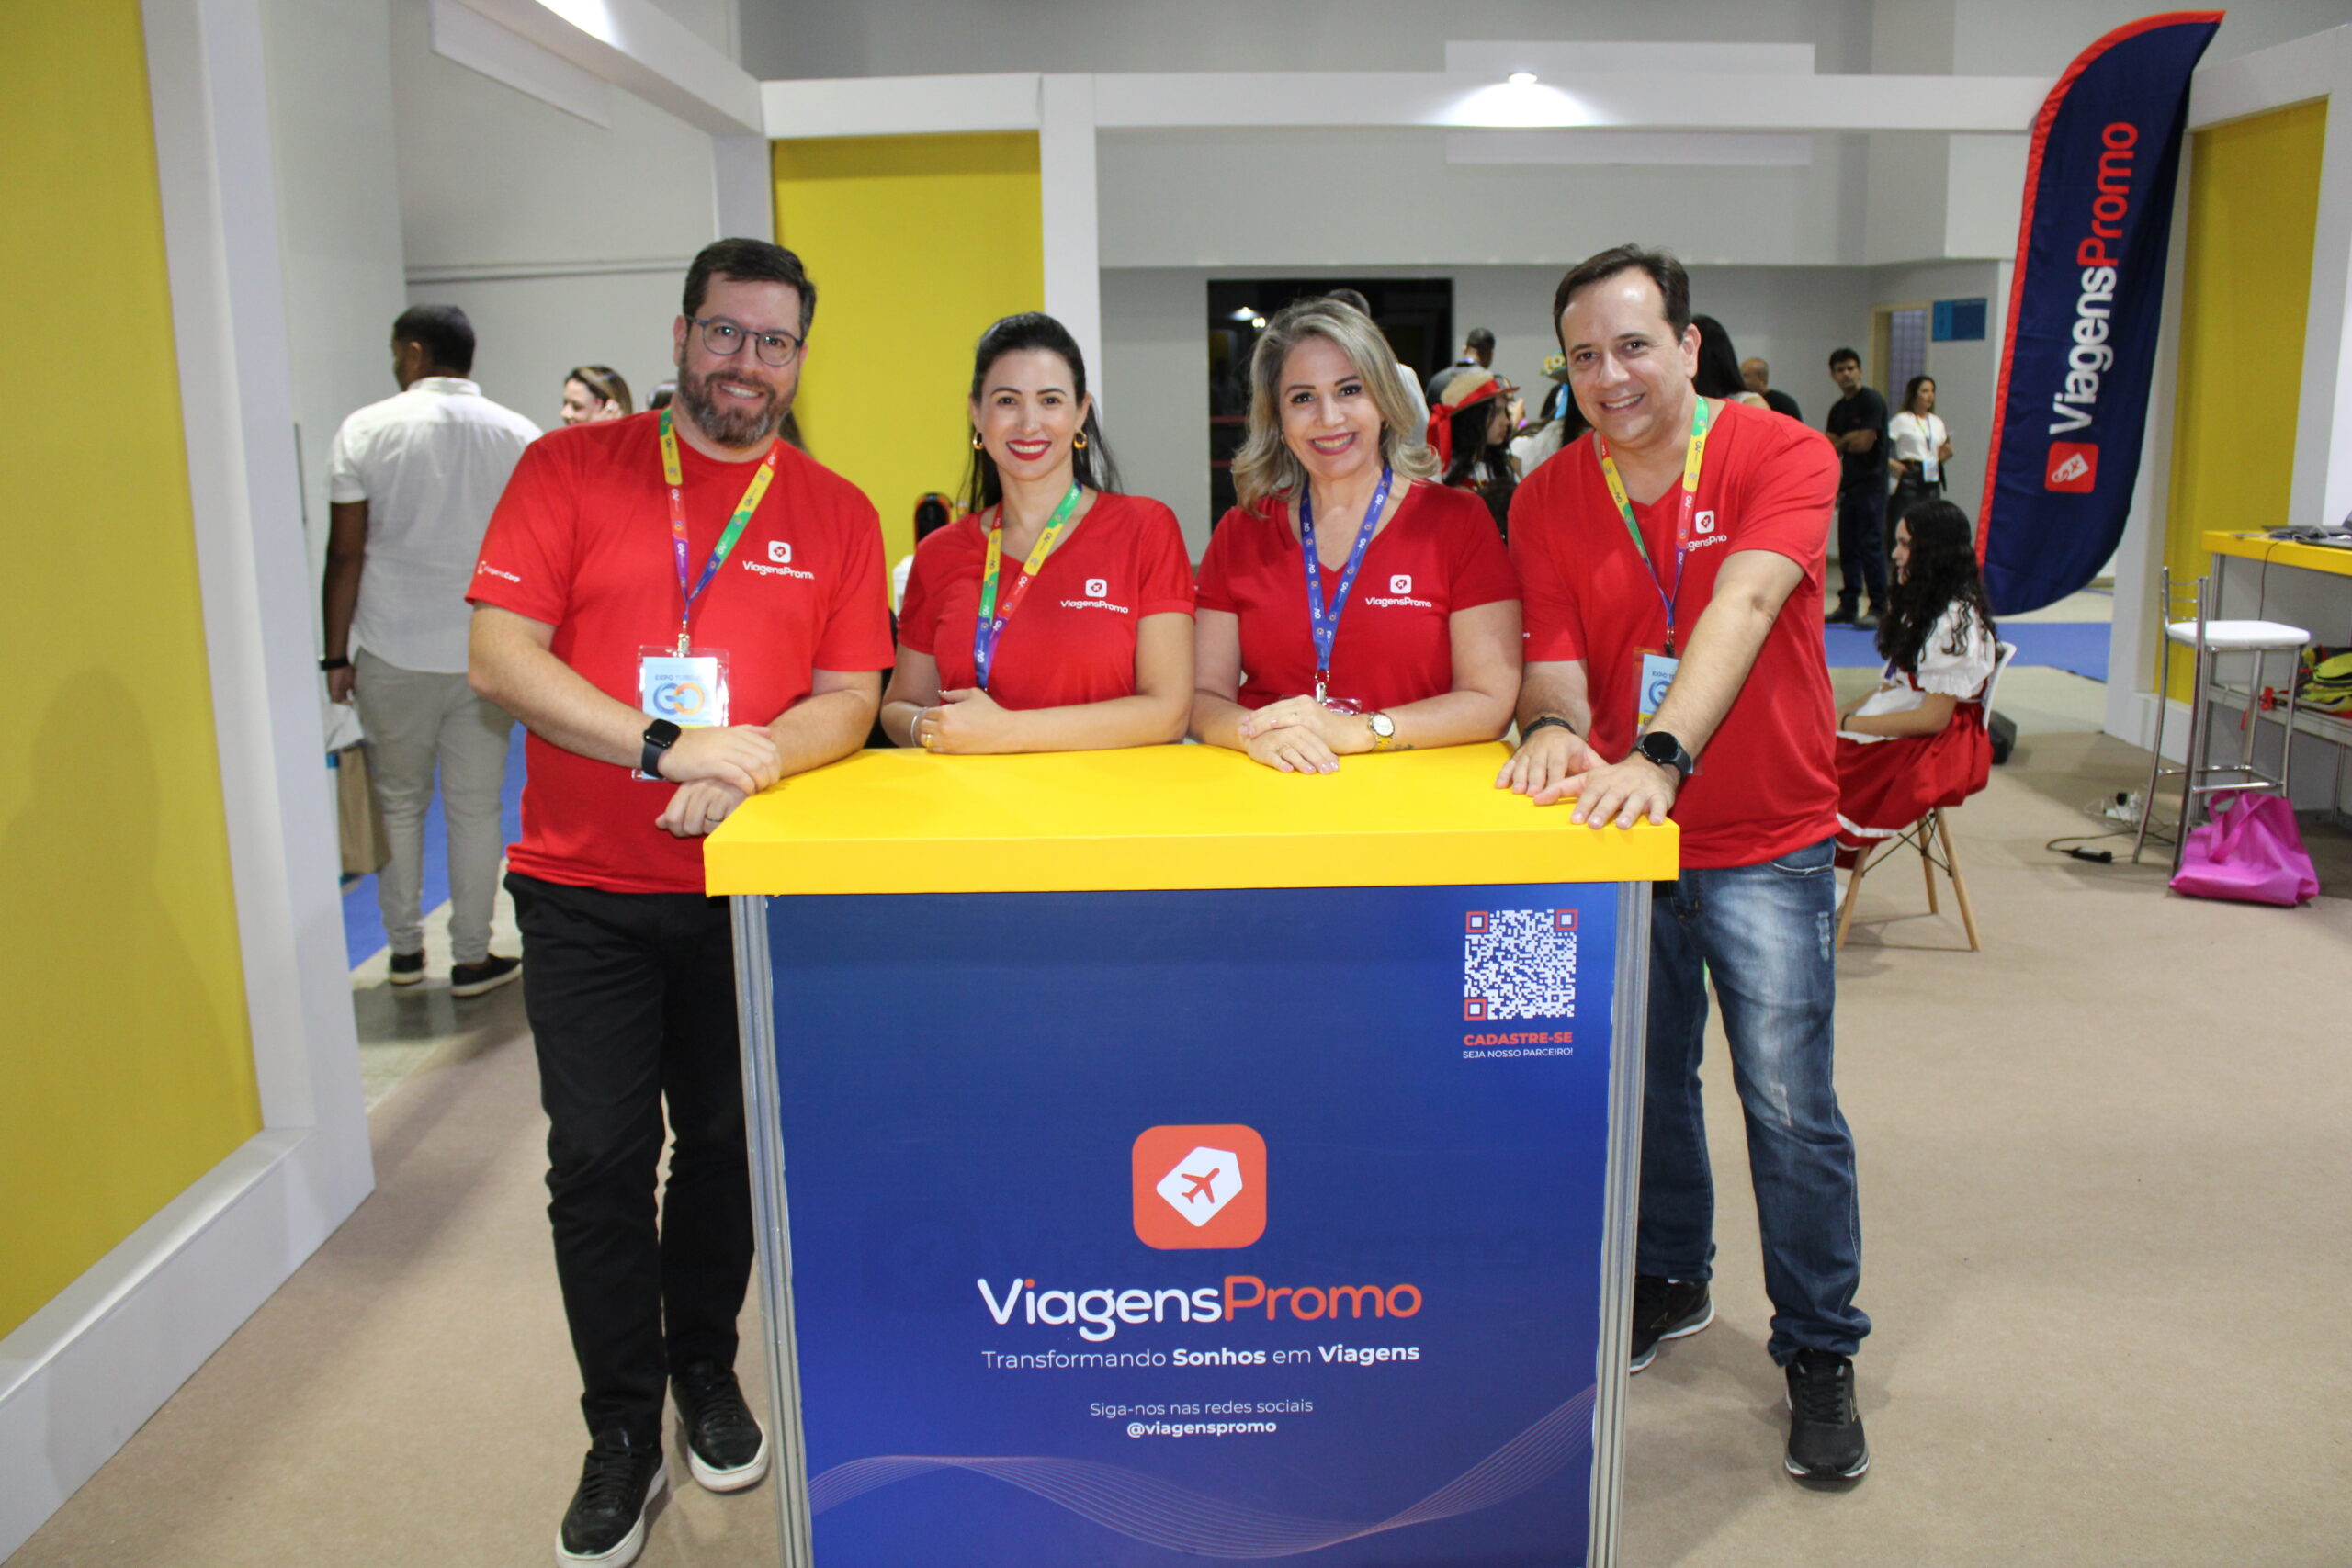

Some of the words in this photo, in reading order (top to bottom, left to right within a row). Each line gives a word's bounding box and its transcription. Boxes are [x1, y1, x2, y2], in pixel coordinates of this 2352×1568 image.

[2048, 122, 2139, 436] ViagensPromo
[1060, 600, 1129, 614] ViagensPromo
[1365, 597, 1432, 607] ViagensPromo
[1463, 1032, 1573, 1045] CADASTRE-SE
[1463, 1050, 1486, 1059] SEJA
[1487, 1049, 1521, 1058] NOSSO
[1522, 1047, 1574, 1056] PARCEIRO!
[977, 1275, 1423, 1342] ViagensPromo
[981, 1349, 1167, 1369] Transformando
[1172, 1348, 1267, 1367] Sonhos
[1272, 1349, 1311, 1365] em
[1317, 1344, 1420, 1367] Viagens
[1090, 1403, 1166, 1419] Siga-nos
[1170, 1403, 1200, 1416] nas
[1204, 1400, 1252, 1416] redes
[1256, 1398, 1314, 1415] sociais
[1126, 1419, 1277, 1438] @viagenspromo
